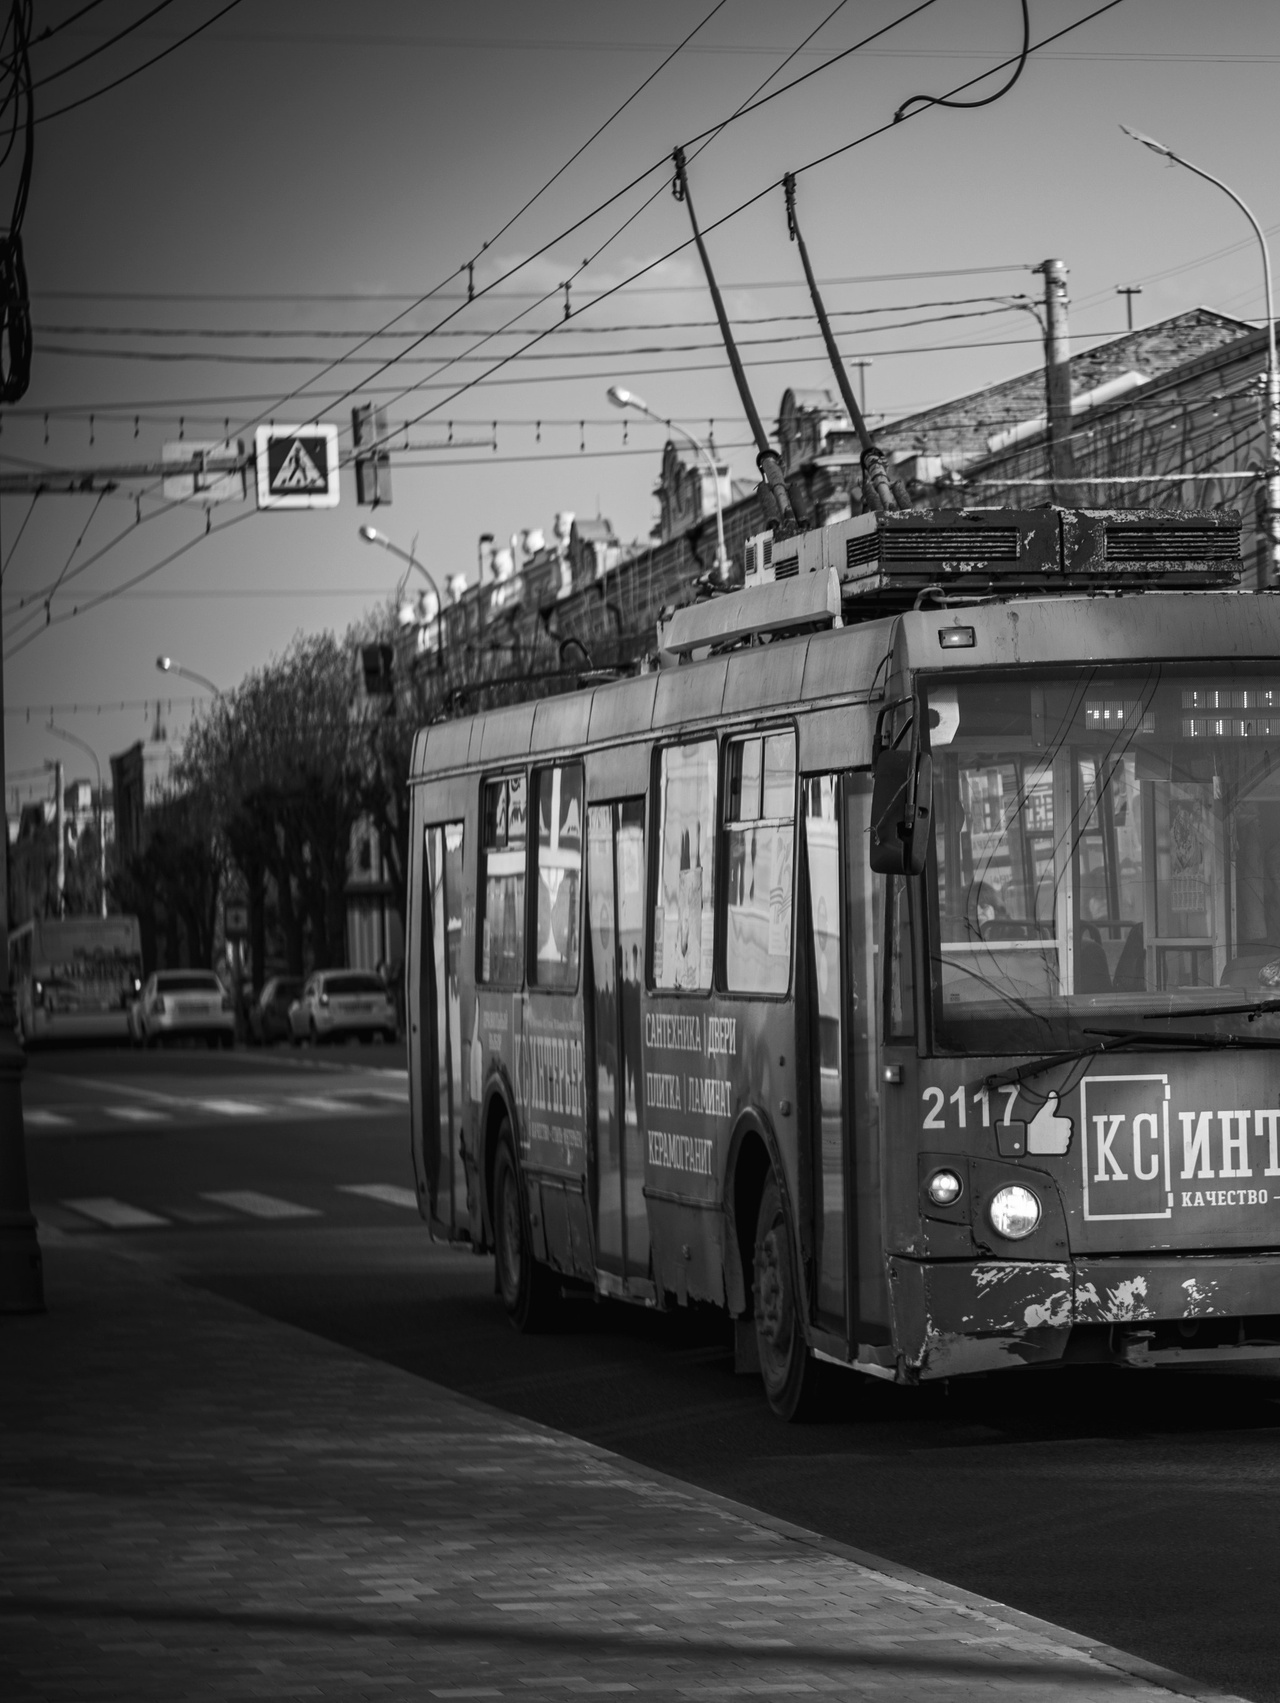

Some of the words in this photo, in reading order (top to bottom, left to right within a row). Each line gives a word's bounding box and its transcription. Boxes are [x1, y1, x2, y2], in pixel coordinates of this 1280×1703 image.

[645, 1013, 702, 1051] САНТЕХНИКА
[708, 1017, 737, 1059] ДВЕРИ
[646, 1072, 682, 1111] ПЛИТКА
[688, 1077, 732, 1118] ЛАМИНАТ
[922, 1085, 1020, 1129] 2117
[648, 1130, 713, 1175] КЕРАМОГРАНИТ
[1092, 1113, 1159, 1181] КС
[1181, 1189, 1268, 1207] КАЧЕСТВО
